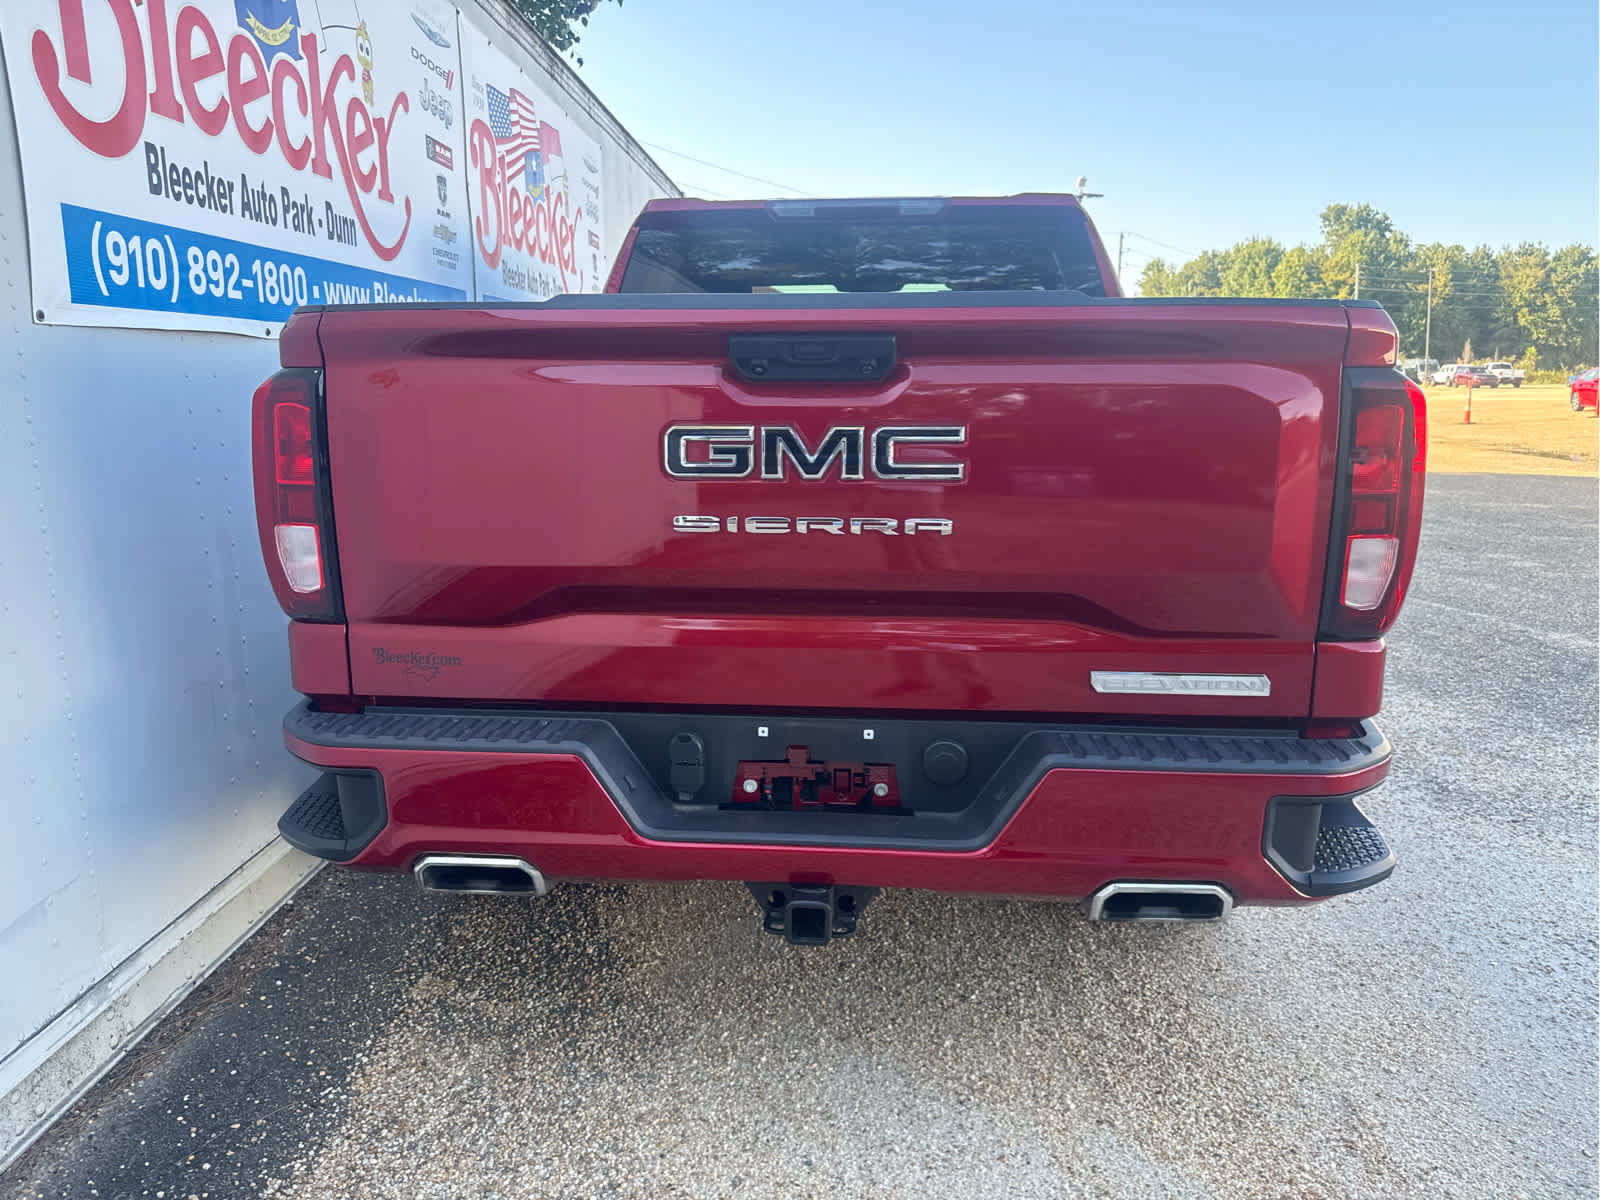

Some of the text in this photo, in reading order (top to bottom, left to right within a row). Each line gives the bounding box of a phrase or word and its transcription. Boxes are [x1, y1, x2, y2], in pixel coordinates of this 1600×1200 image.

[410, 46, 449, 81] DODGE
[419, 77, 452, 130] Jeep
[144, 140, 358, 247] Bleecker Auto Park Dunn
[469, 118, 583, 293] Bleecker
[91, 221, 180, 303] (910)
[187, 246, 308, 306] 892-1800
[663, 425, 966, 480] GMC
[672, 515, 953, 536] SIERRA
[1101, 677, 1266, 692] ELEVATION
